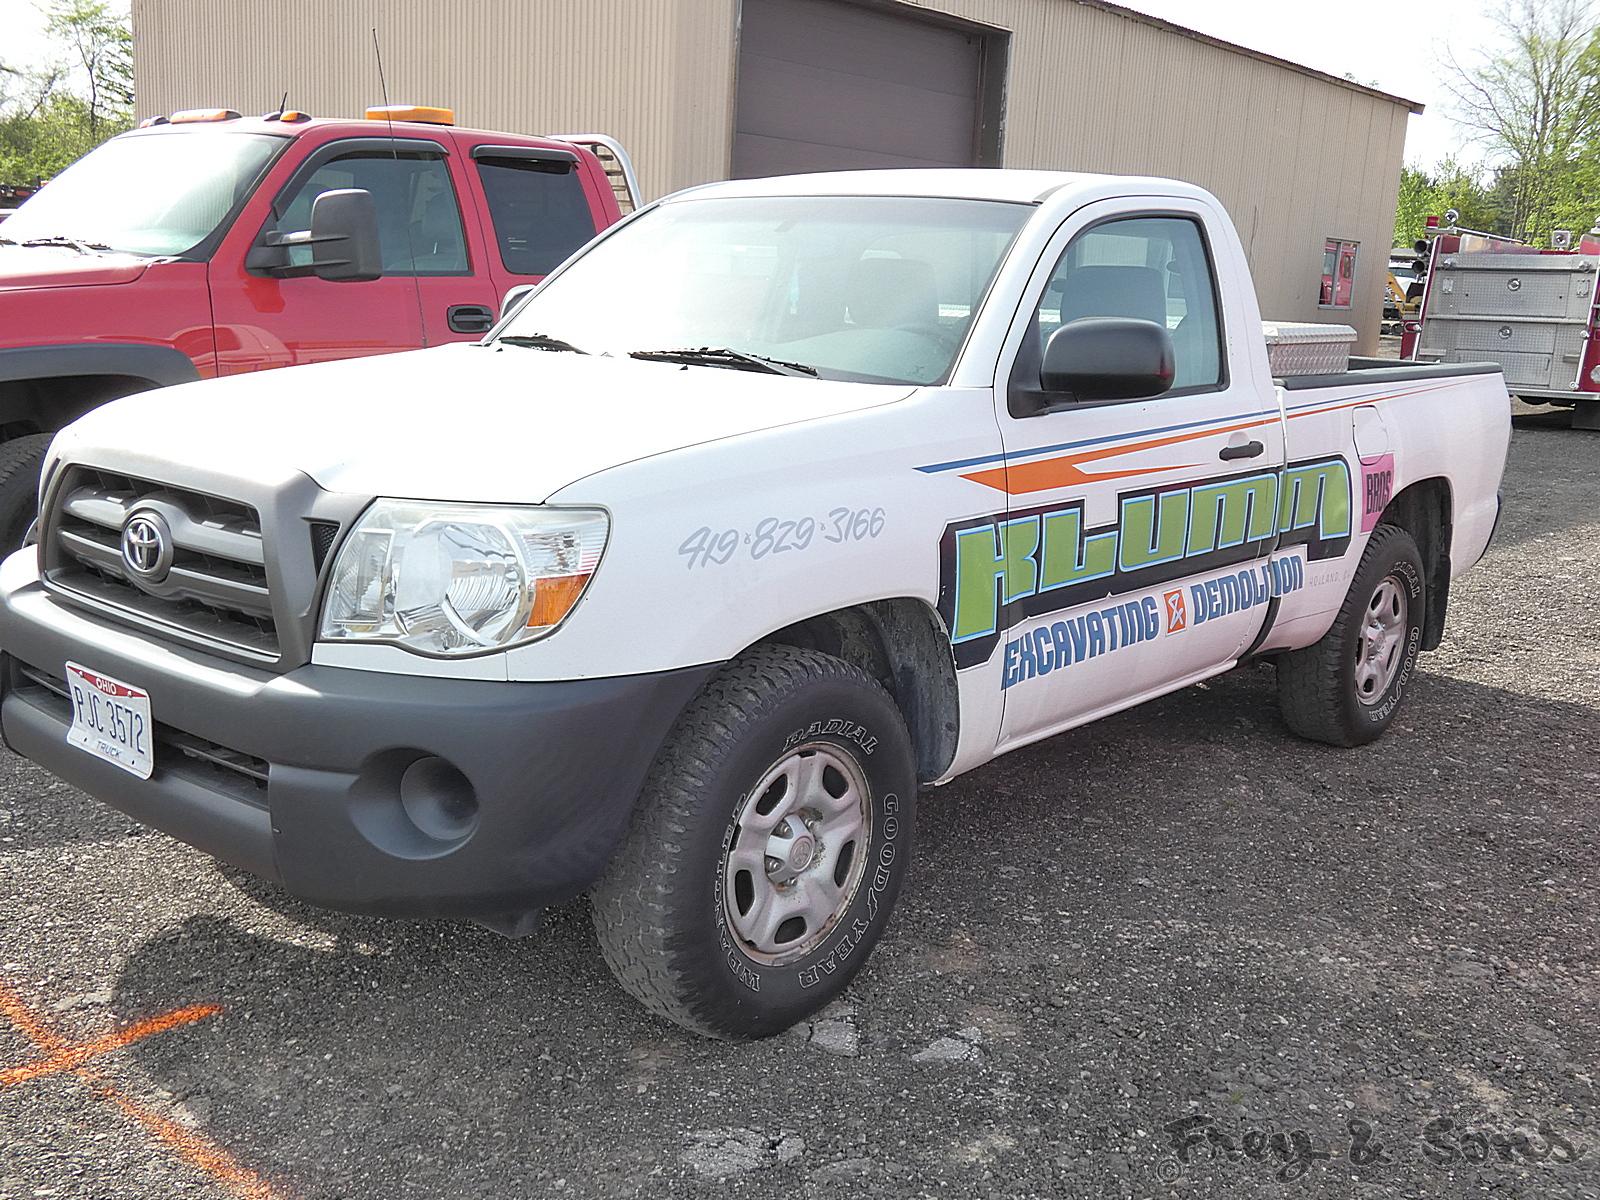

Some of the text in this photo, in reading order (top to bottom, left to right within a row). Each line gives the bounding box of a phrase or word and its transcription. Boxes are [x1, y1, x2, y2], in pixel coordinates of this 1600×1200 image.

[1366, 470, 1392, 515] BROS
[951, 459, 1352, 644] KLUMM
[1002, 597, 1159, 690] EXCAVATING
[1190, 555, 1304, 626] DEMOLITION
[97, 678, 117, 695] OHIO
[74, 686, 144, 755] PJC 3572
[97, 741, 121, 757] TRUCK
[783, 718, 879, 756] RADIAL
[799, 793, 900, 989] GOODYEAR
